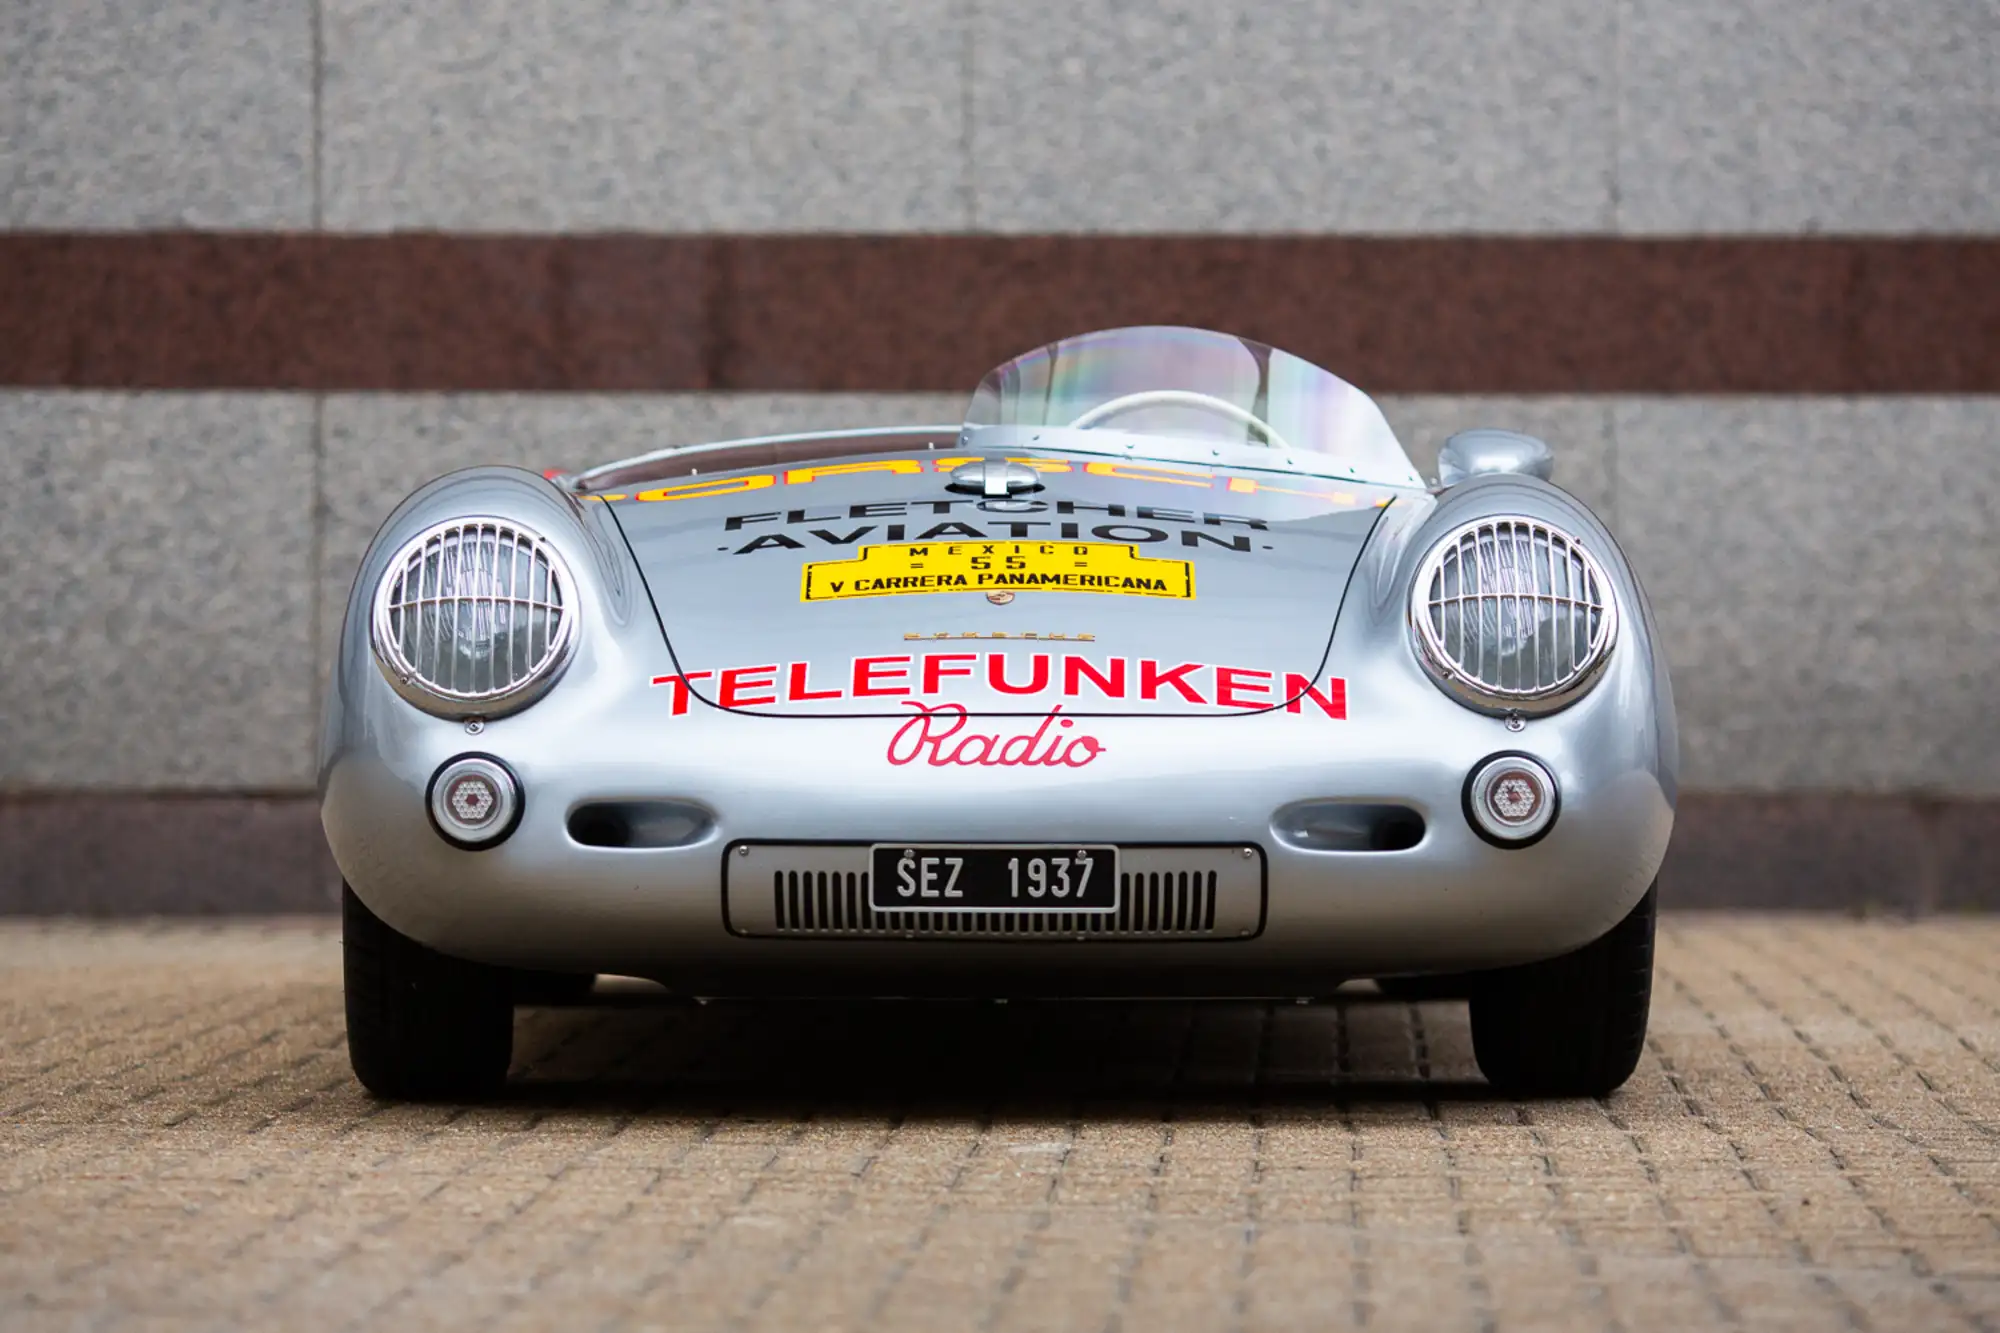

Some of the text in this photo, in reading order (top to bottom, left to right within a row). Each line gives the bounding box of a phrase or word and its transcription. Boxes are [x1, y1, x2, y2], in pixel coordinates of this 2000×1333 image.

[724, 500, 1268, 531] FLETCHER
[909, 545, 1088, 556] MEXICO
[830, 573, 1167, 592] V CARRERA PANAMERICANA
[651, 653, 1348, 721] TELEFUNKEN
[887, 700, 1106, 768] Radio
[897, 857, 1093, 897] SEZ 1937
